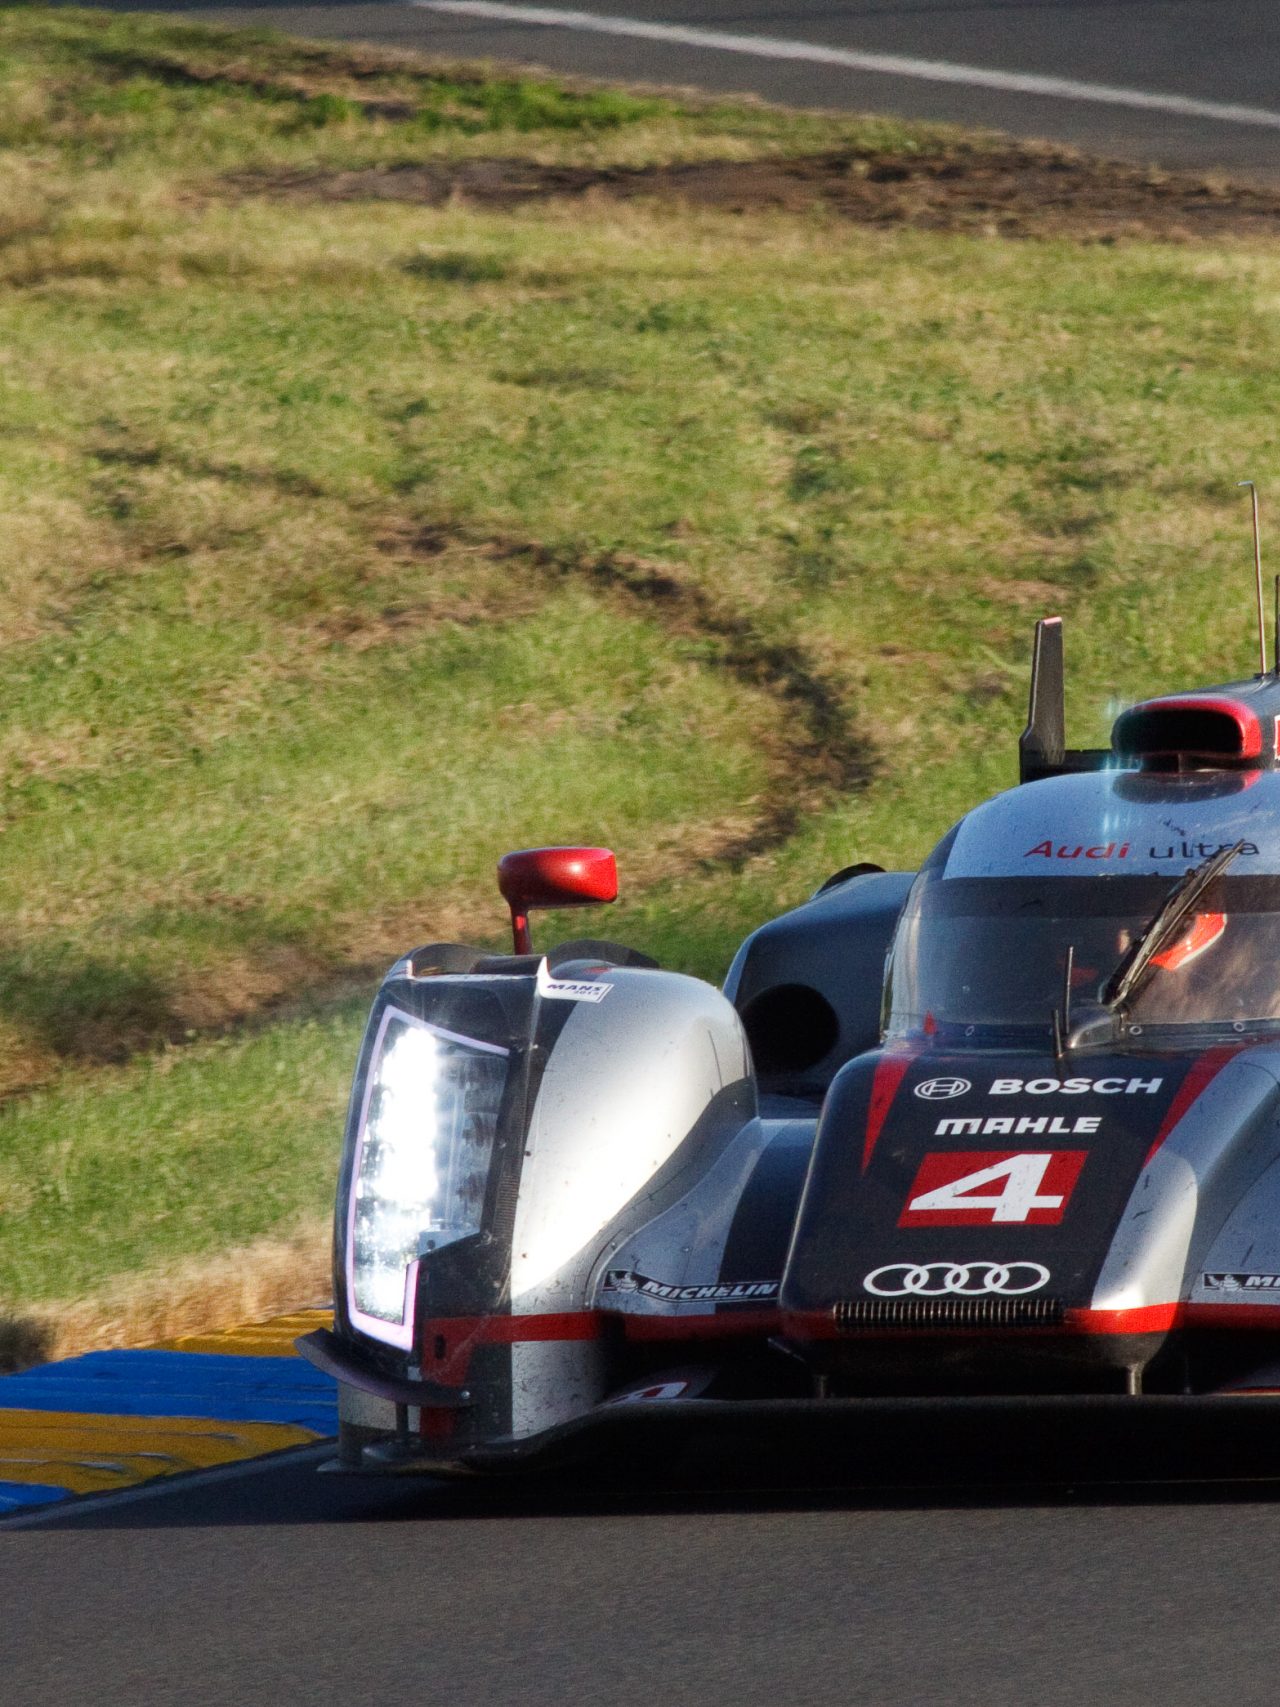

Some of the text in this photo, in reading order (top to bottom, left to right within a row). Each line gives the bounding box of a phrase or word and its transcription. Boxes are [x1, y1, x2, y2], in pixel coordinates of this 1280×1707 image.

[1023, 840, 1261, 859] Audi ultra
[988, 1077, 1164, 1096] BOSCH
[934, 1116, 1102, 1136] MAHLE
[908, 1153, 1065, 1223] 4
[641, 1281, 778, 1300] MICHELIN
